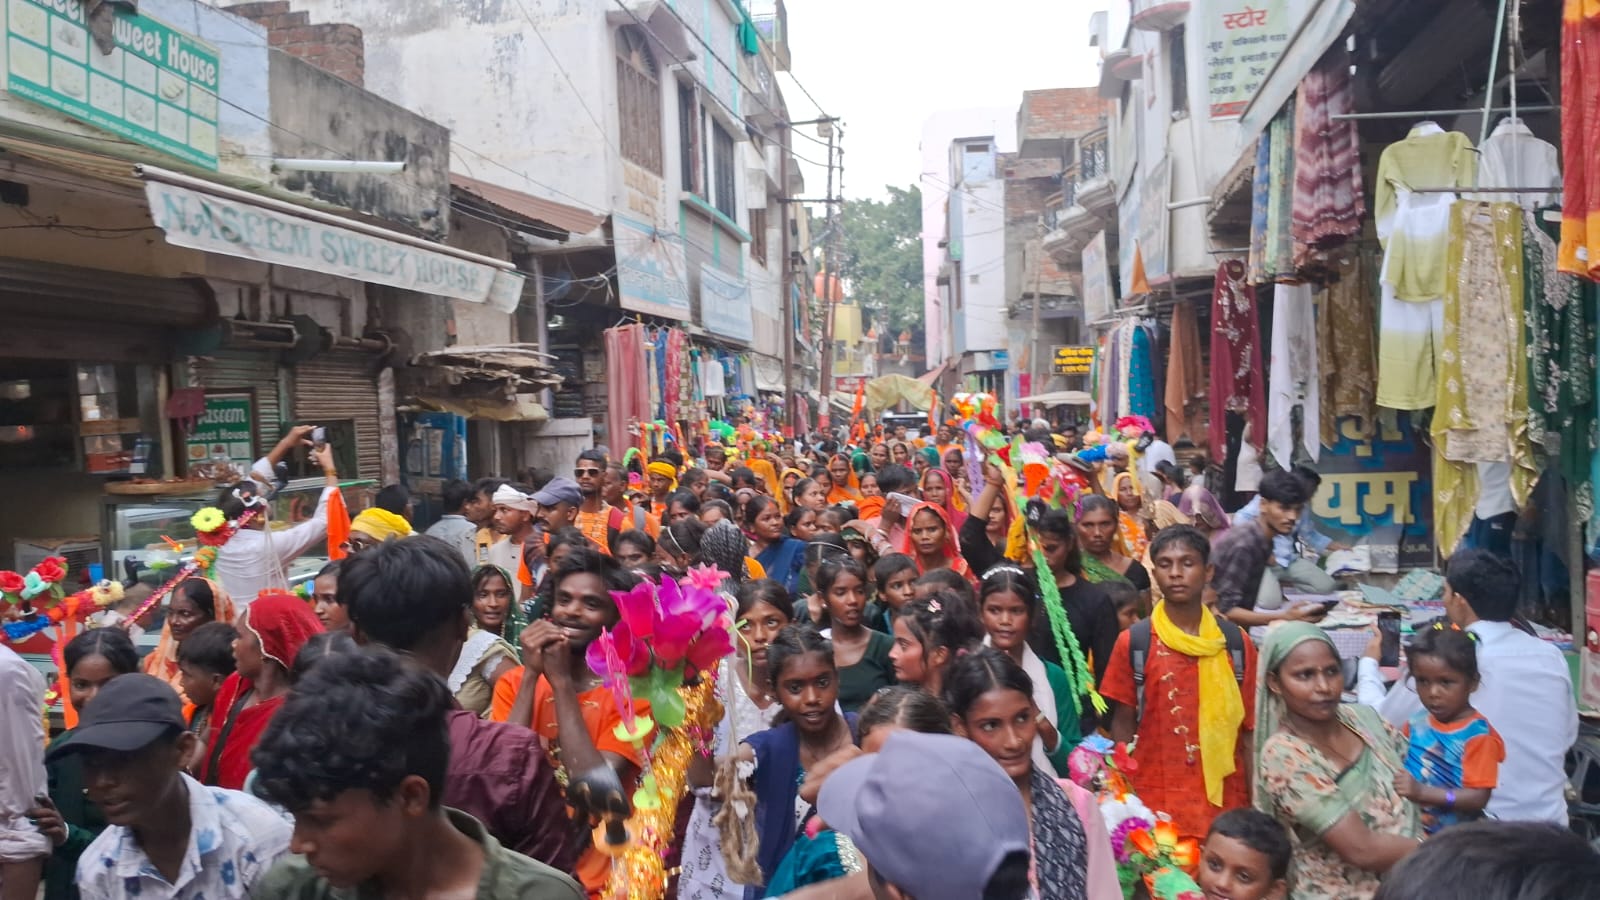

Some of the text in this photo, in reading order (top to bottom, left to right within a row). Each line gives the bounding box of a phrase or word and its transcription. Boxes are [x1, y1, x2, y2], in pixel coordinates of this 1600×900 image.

[1222, 6, 1268, 30] स्टोर
[112, 18, 161, 61] weet
[168, 34, 216, 86] House
[160, 192, 312, 256] NASEEM
[321, 230, 408, 276] SWEET
[414, 254, 483, 293] HOUSE
[197, 407, 246, 425] aseem
[220, 428, 250, 440] House
